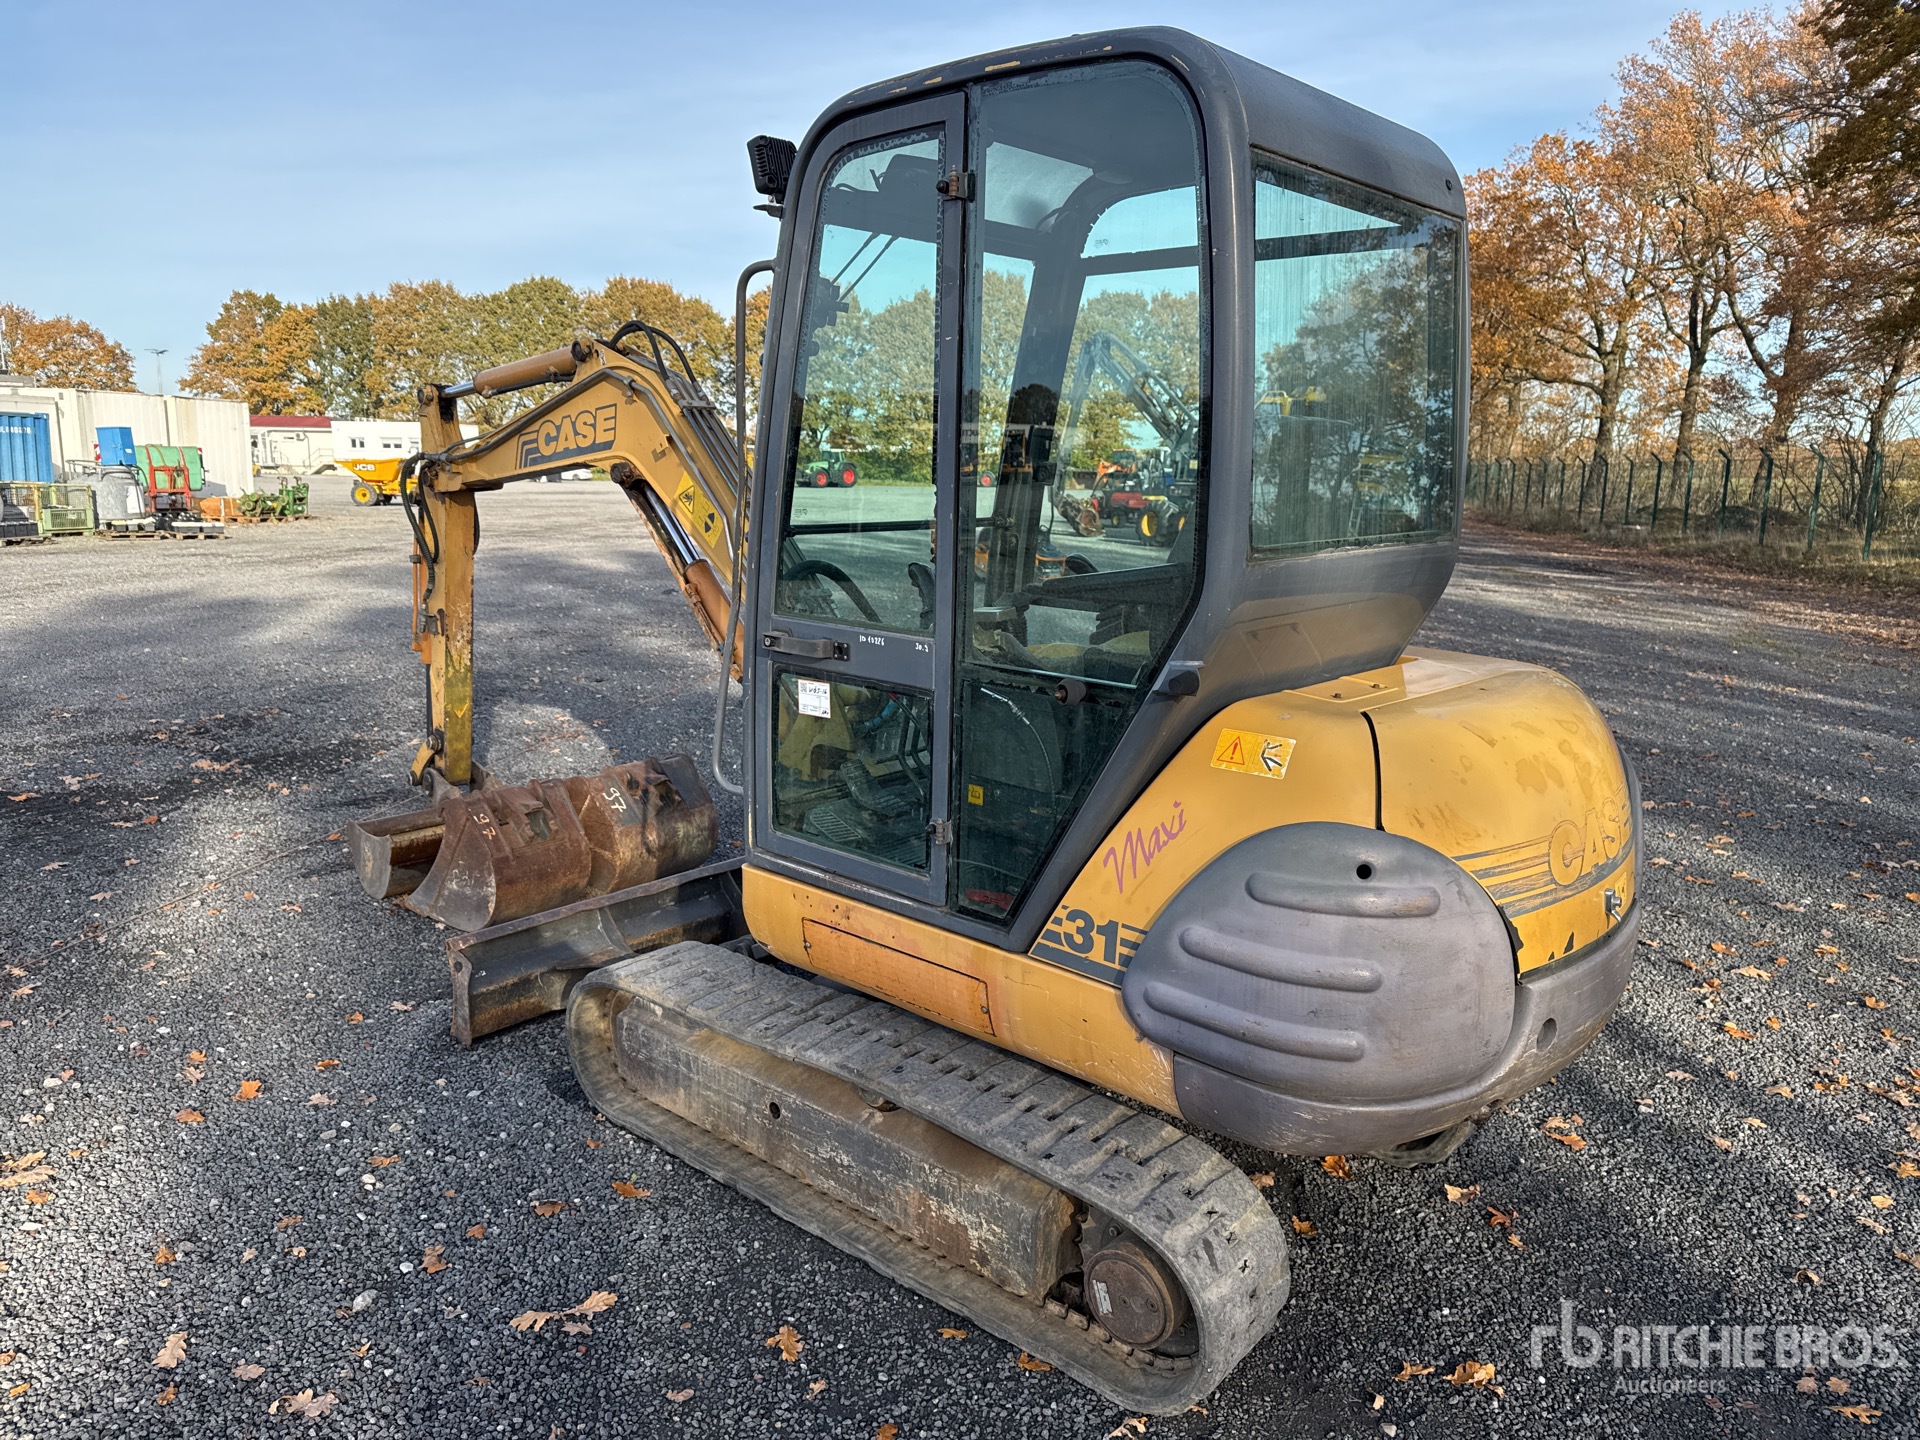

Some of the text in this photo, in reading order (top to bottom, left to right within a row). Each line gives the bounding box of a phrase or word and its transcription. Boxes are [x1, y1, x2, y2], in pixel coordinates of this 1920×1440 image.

[538, 403, 617, 456] CASE
[353, 463, 375, 471] JCB
[602, 787, 627, 813] 97
[1103, 800, 1187, 894] Maxi
[1063, 908, 1119, 965] 31
